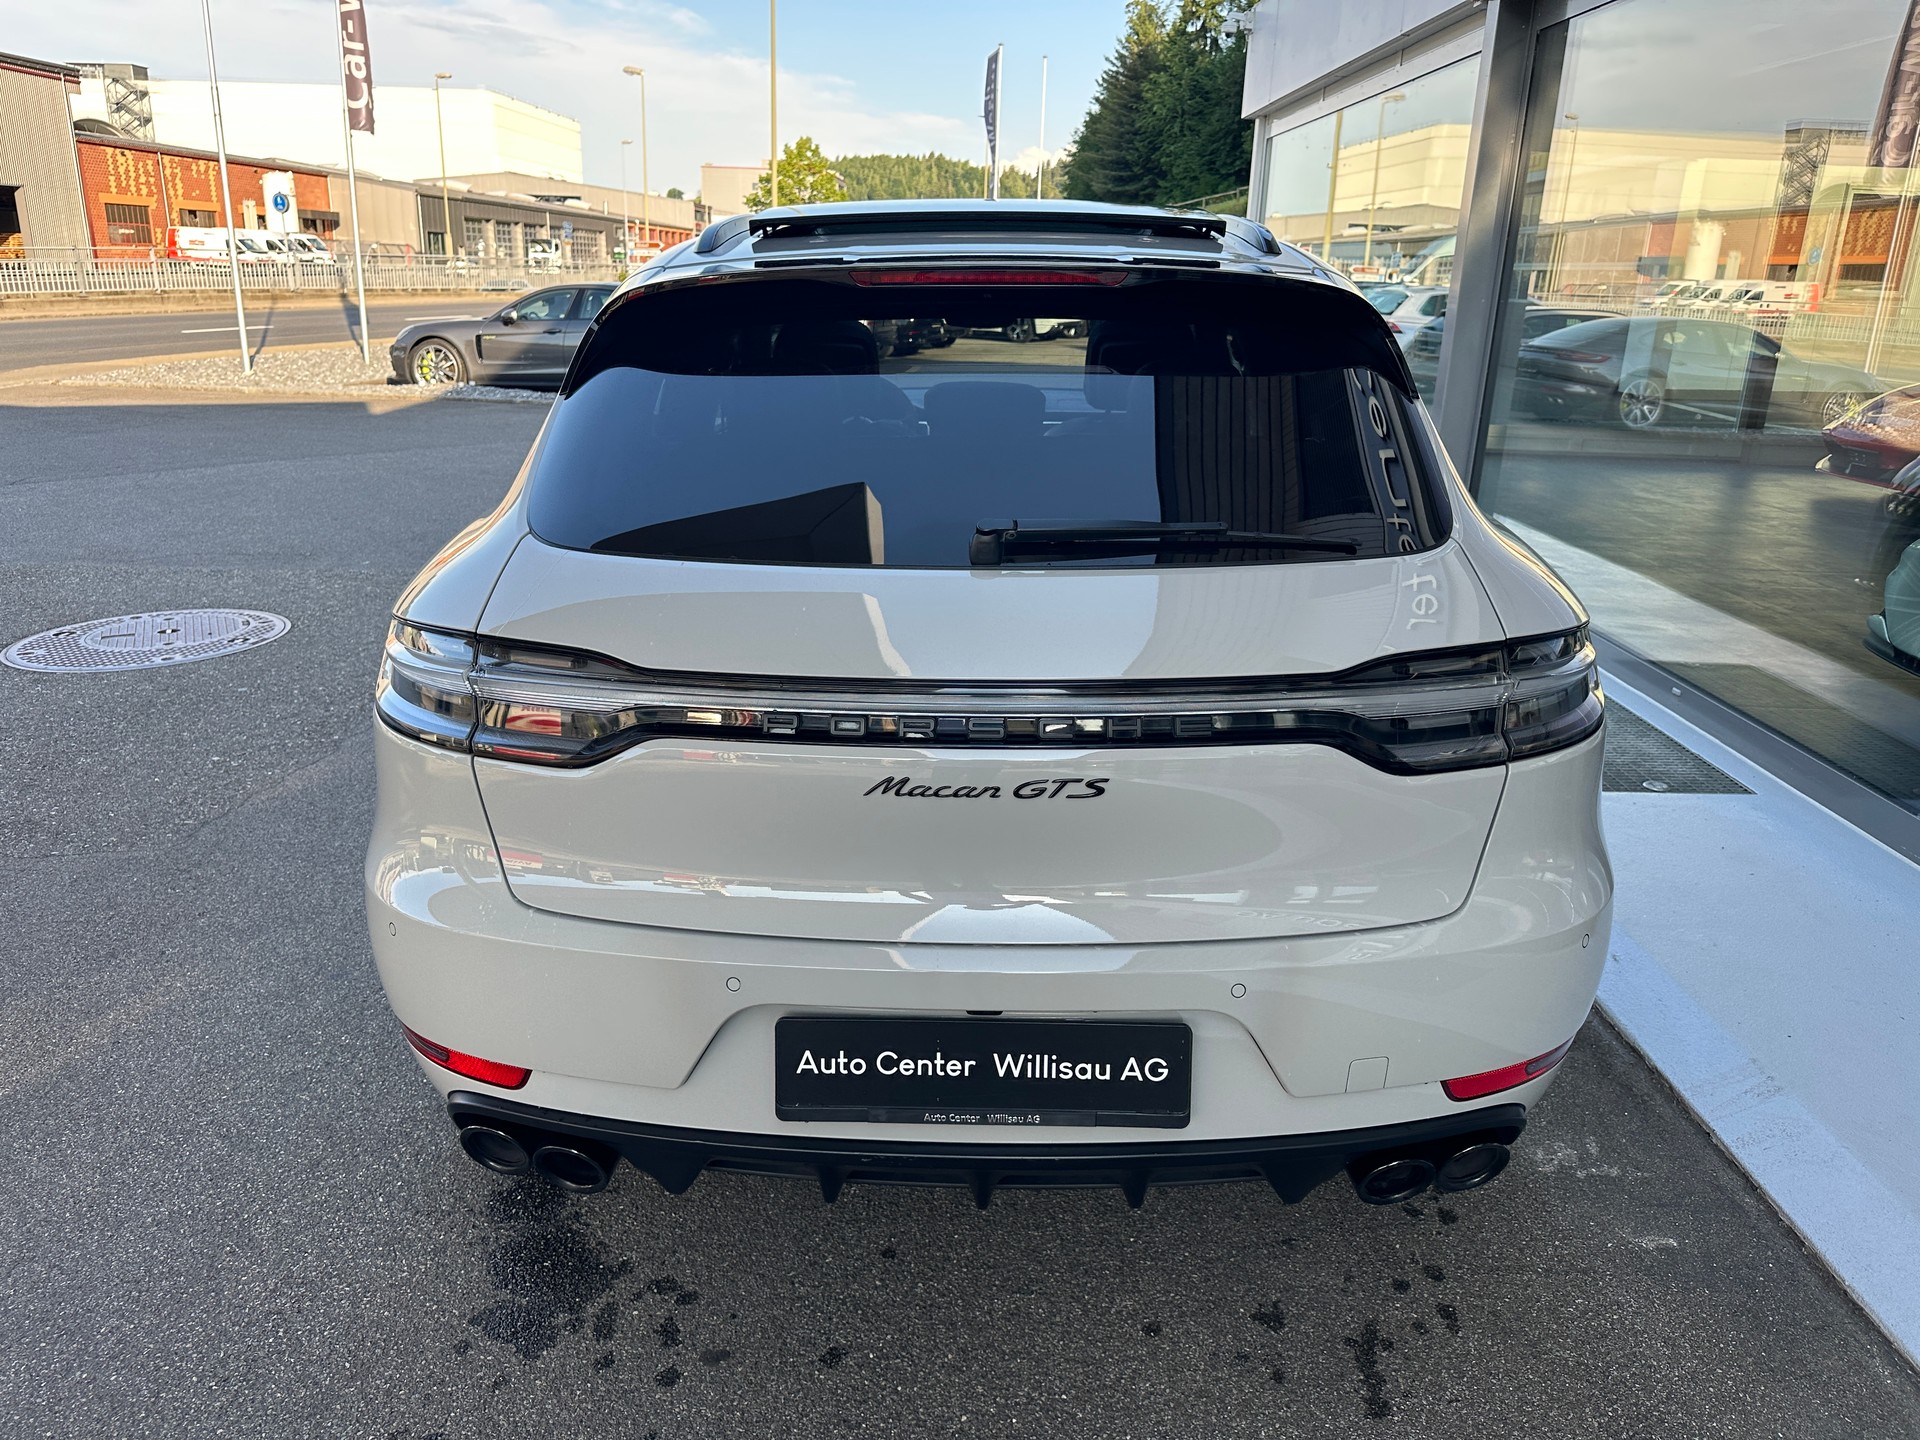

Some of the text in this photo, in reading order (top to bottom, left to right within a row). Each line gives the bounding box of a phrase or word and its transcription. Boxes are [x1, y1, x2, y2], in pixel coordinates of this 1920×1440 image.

[763, 712, 1213, 740] PORSCHE
[863, 775, 1110, 799] Macan GTS
[796, 1049, 1169, 1082] Auto Center Willisau AG
[923, 1113, 1041, 1124] Auto Center Willisau AG
